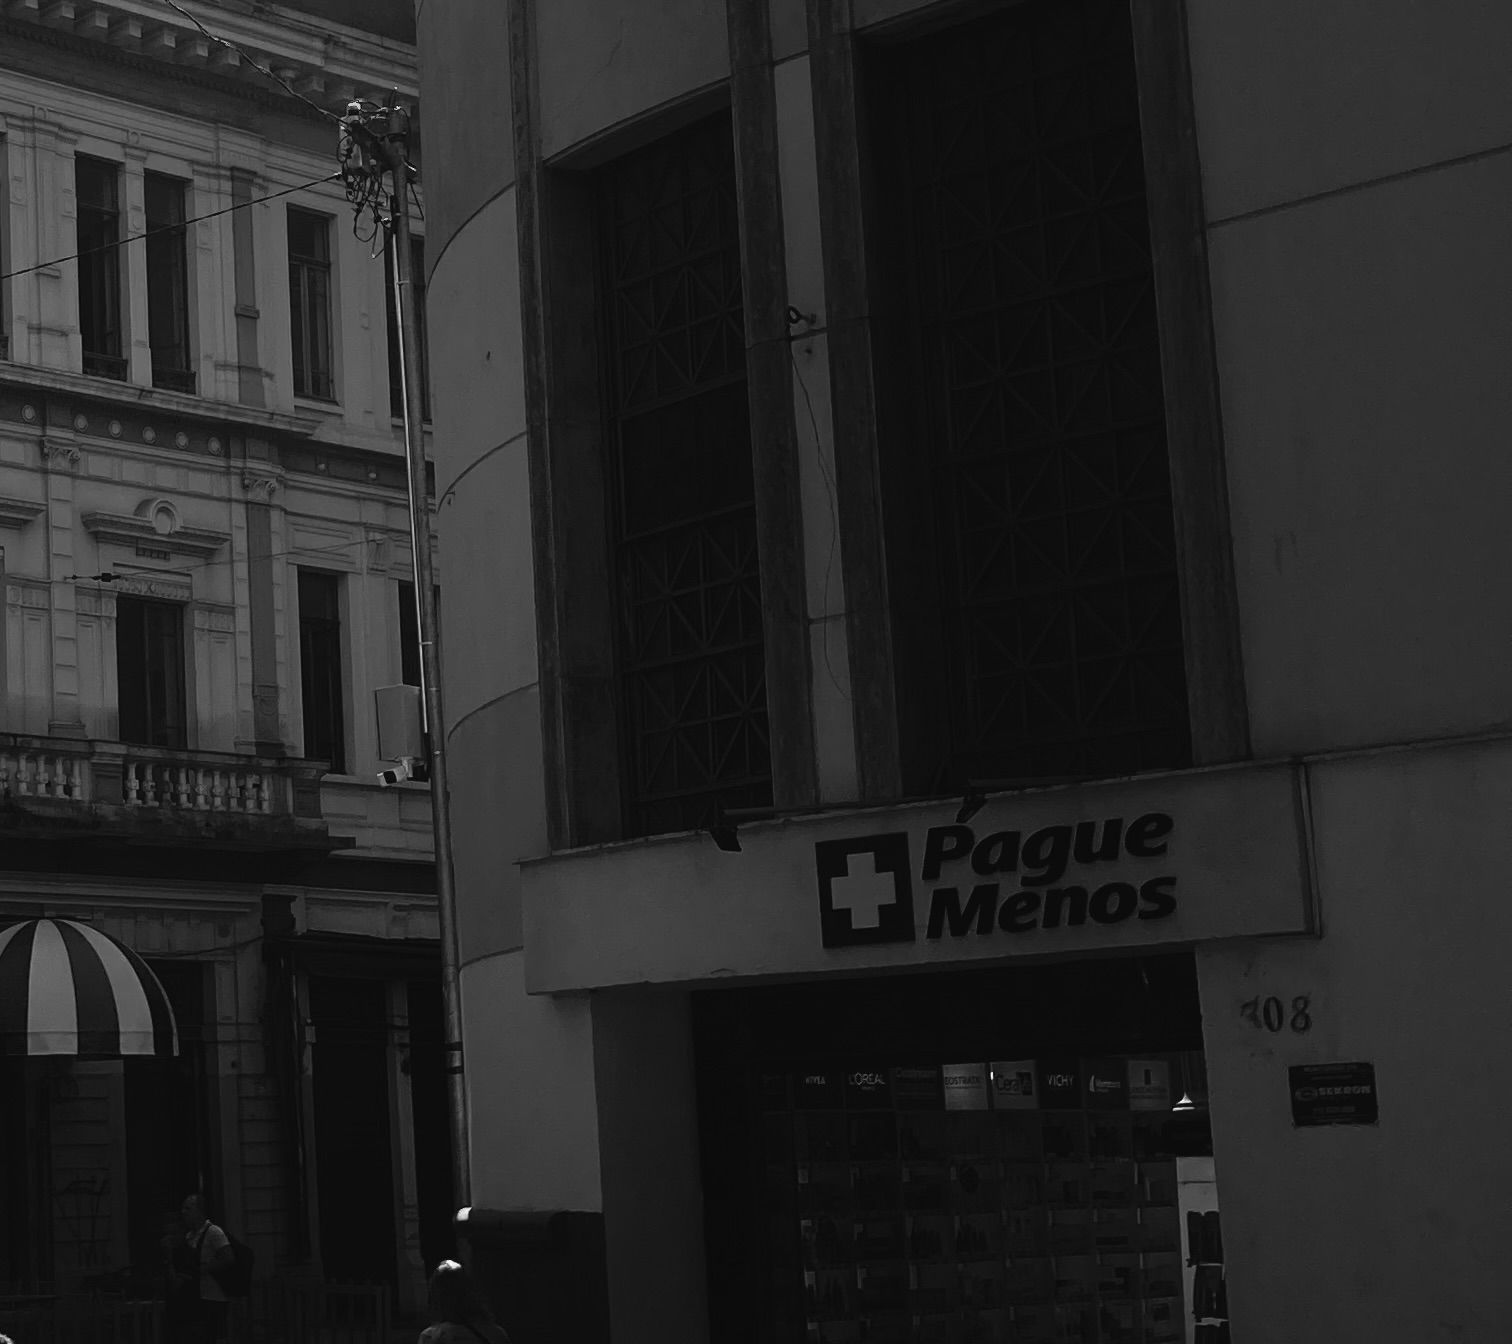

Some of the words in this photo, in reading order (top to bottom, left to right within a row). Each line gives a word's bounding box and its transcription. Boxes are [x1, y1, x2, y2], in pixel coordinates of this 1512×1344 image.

[921, 812, 1175, 887] Pague
[926, 876, 1178, 940] Menos
[1047, 1074, 1074, 1087] VICHY
